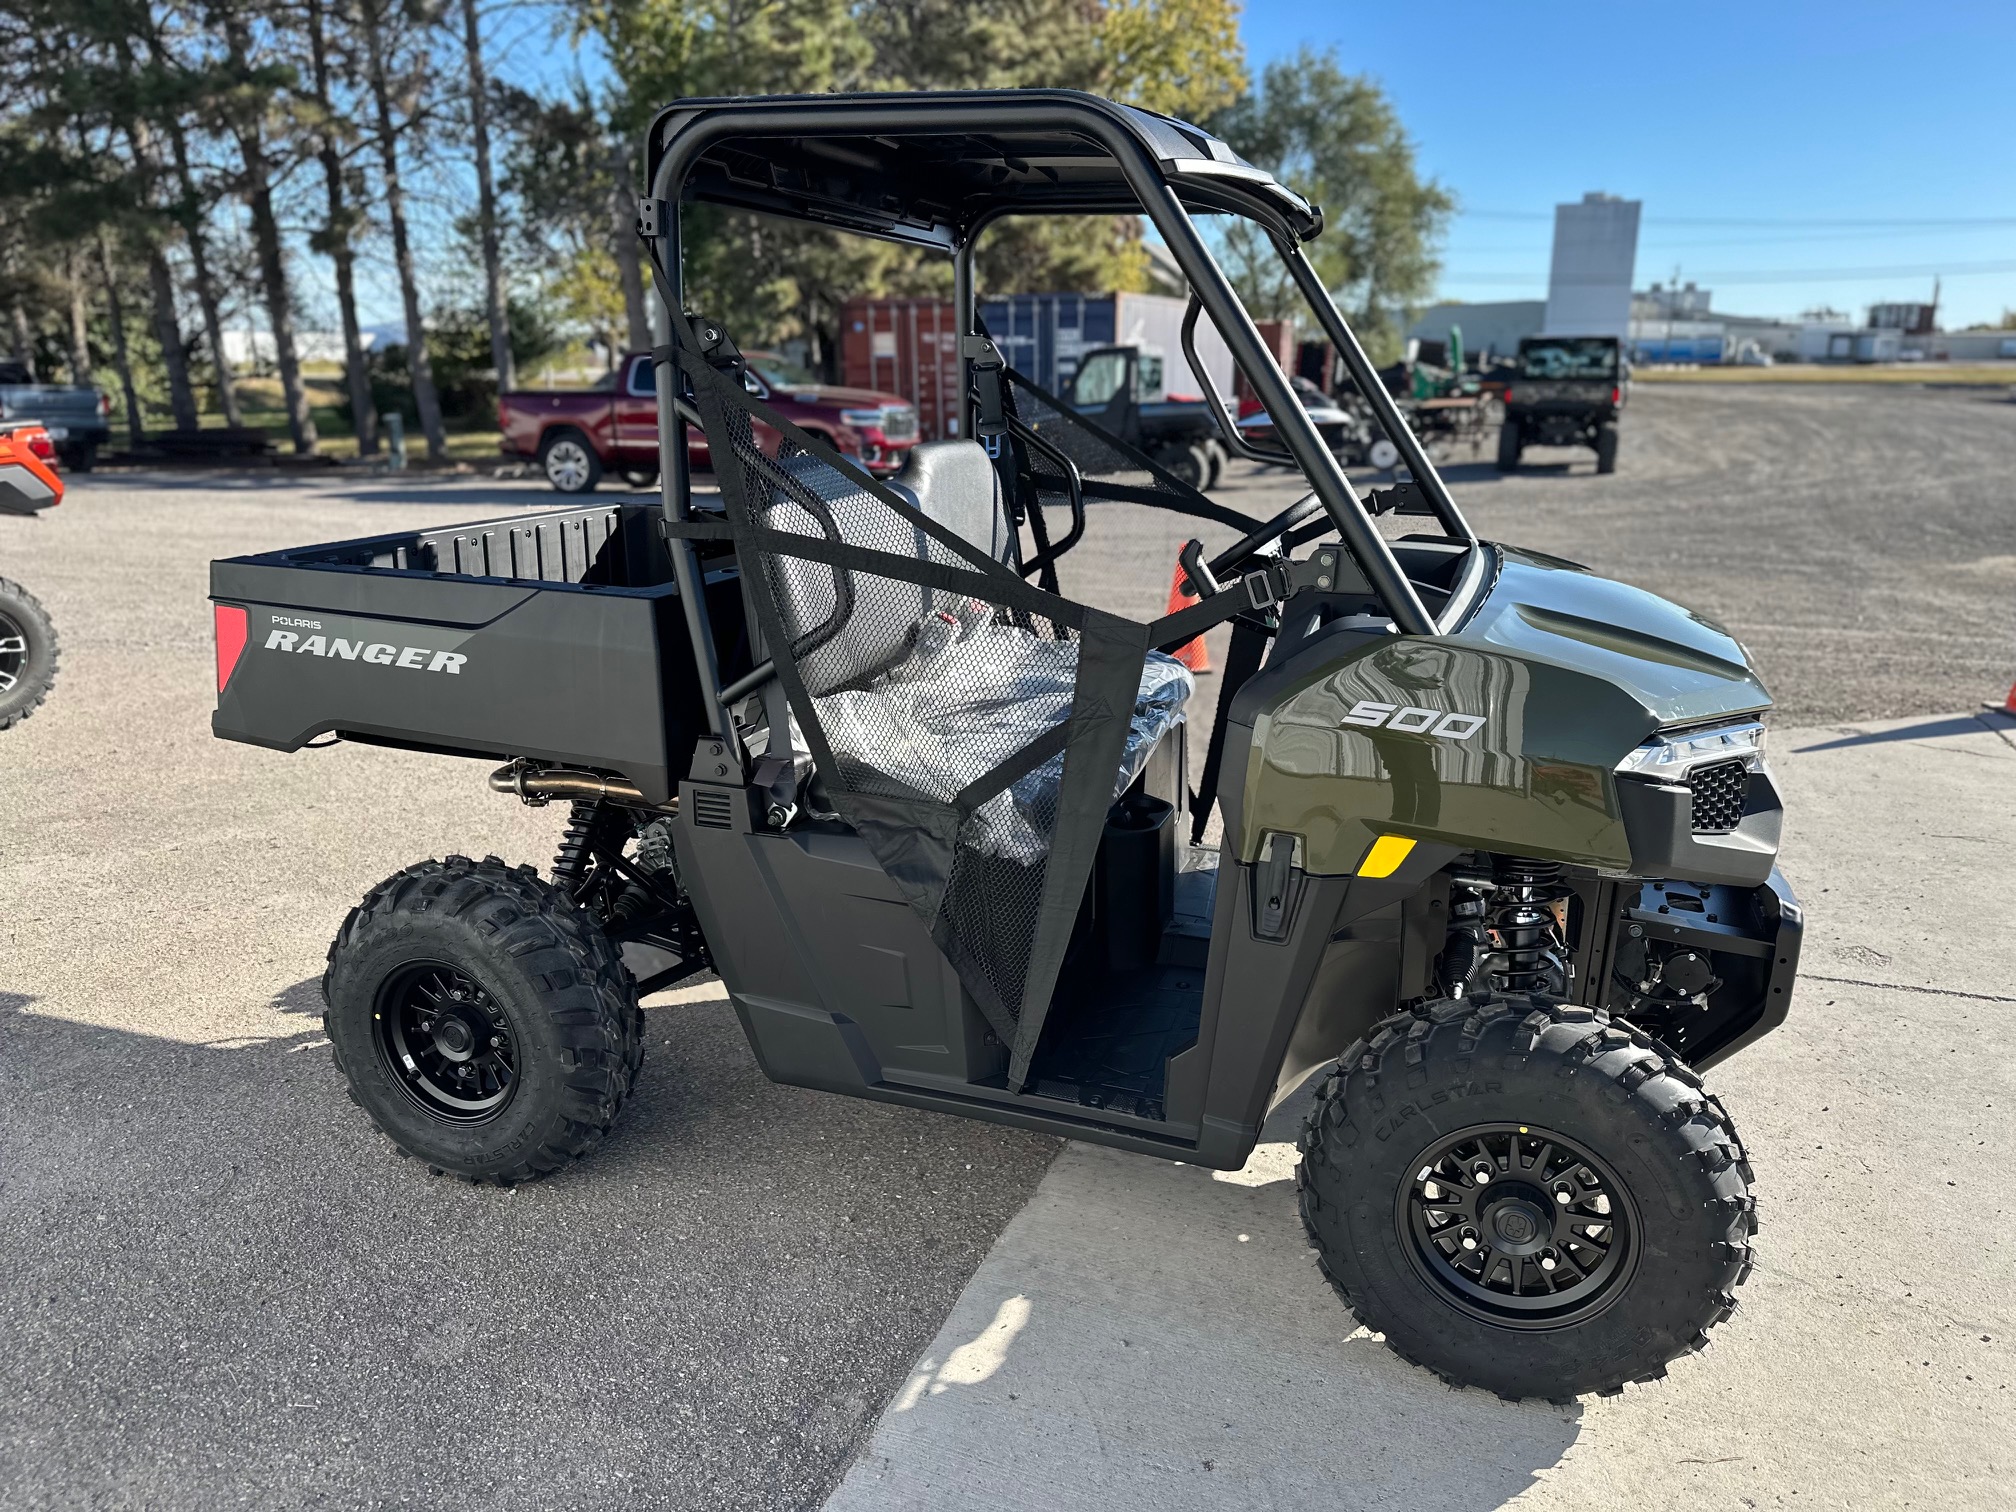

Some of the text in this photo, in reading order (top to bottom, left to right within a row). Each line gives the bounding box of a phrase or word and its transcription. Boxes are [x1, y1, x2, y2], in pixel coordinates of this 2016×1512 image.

[271, 615, 322, 629] POLARIS
[264, 630, 468, 675] RANGER
[1340, 700, 1487, 740] 500
[1374, 1081, 1505, 1143] CARLSTAR
[463, 1121, 537, 1166] CARLSTAR
